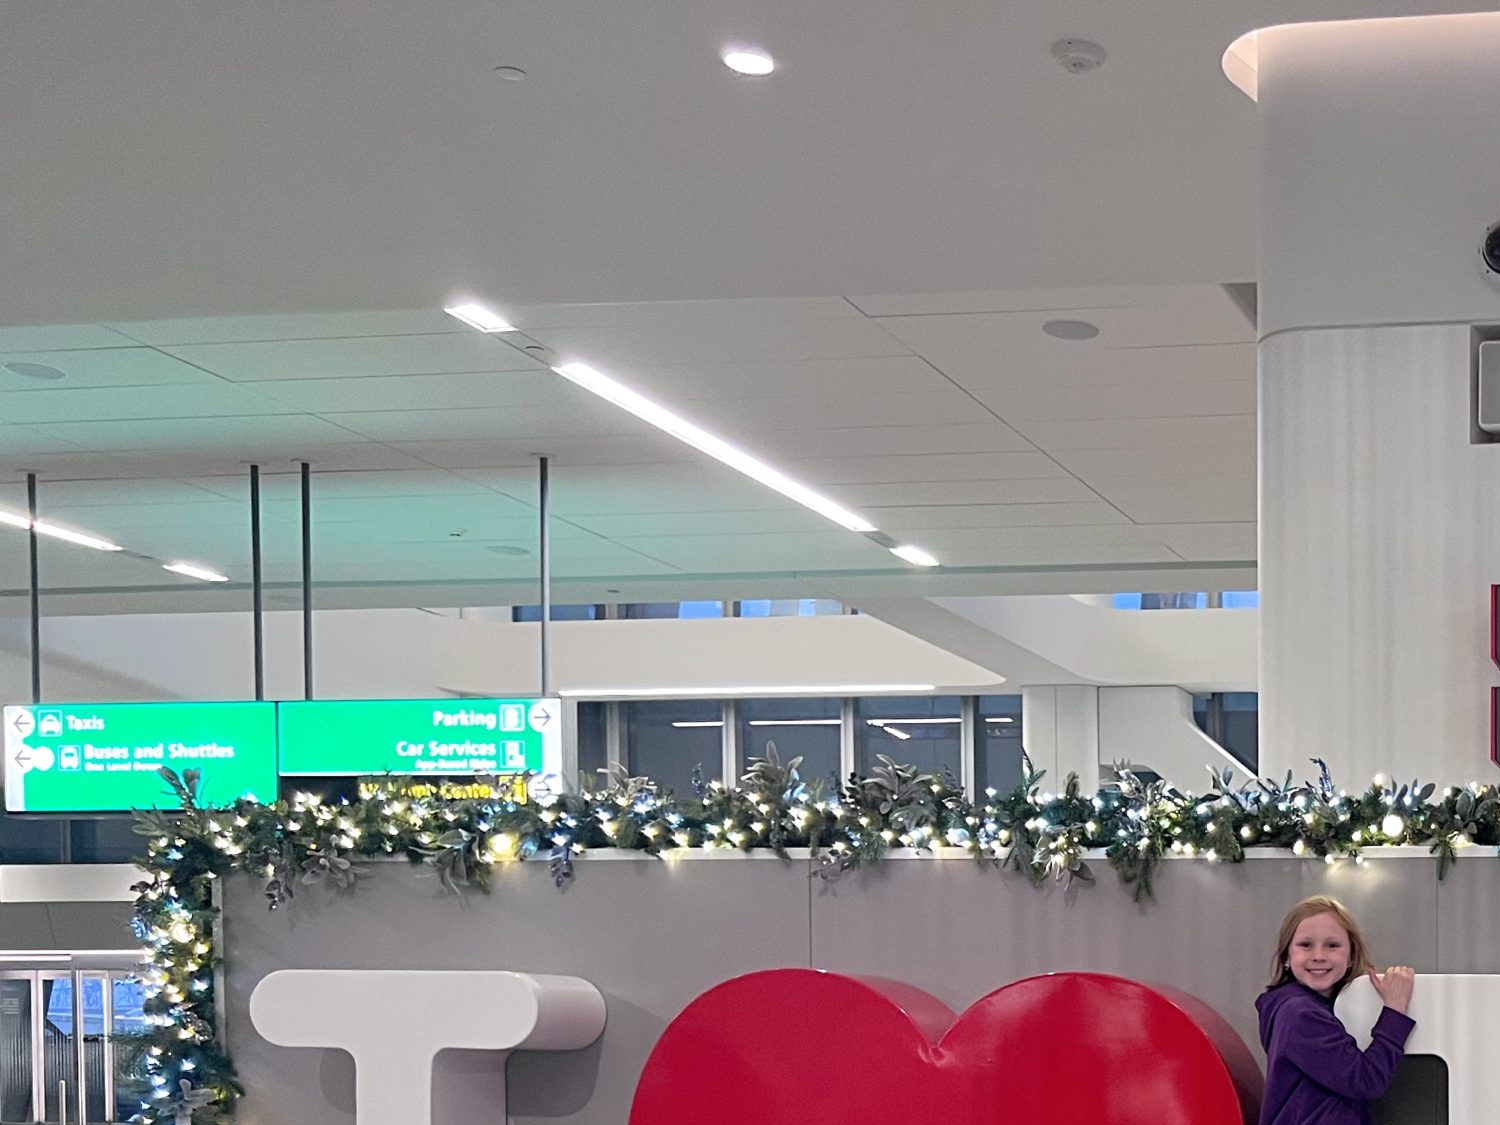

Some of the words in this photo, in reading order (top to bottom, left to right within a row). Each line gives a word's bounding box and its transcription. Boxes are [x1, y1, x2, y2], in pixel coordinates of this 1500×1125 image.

[65, 714, 105, 731] Taxis
[433, 709, 497, 730] Parking
[84, 744, 129, 759] Buses
[134, 743, 164, 759] and
[168, 742, 235, 758] Shuttles
[396, 741, 425, 756] Car
[428, 740, 497, 756] Services
